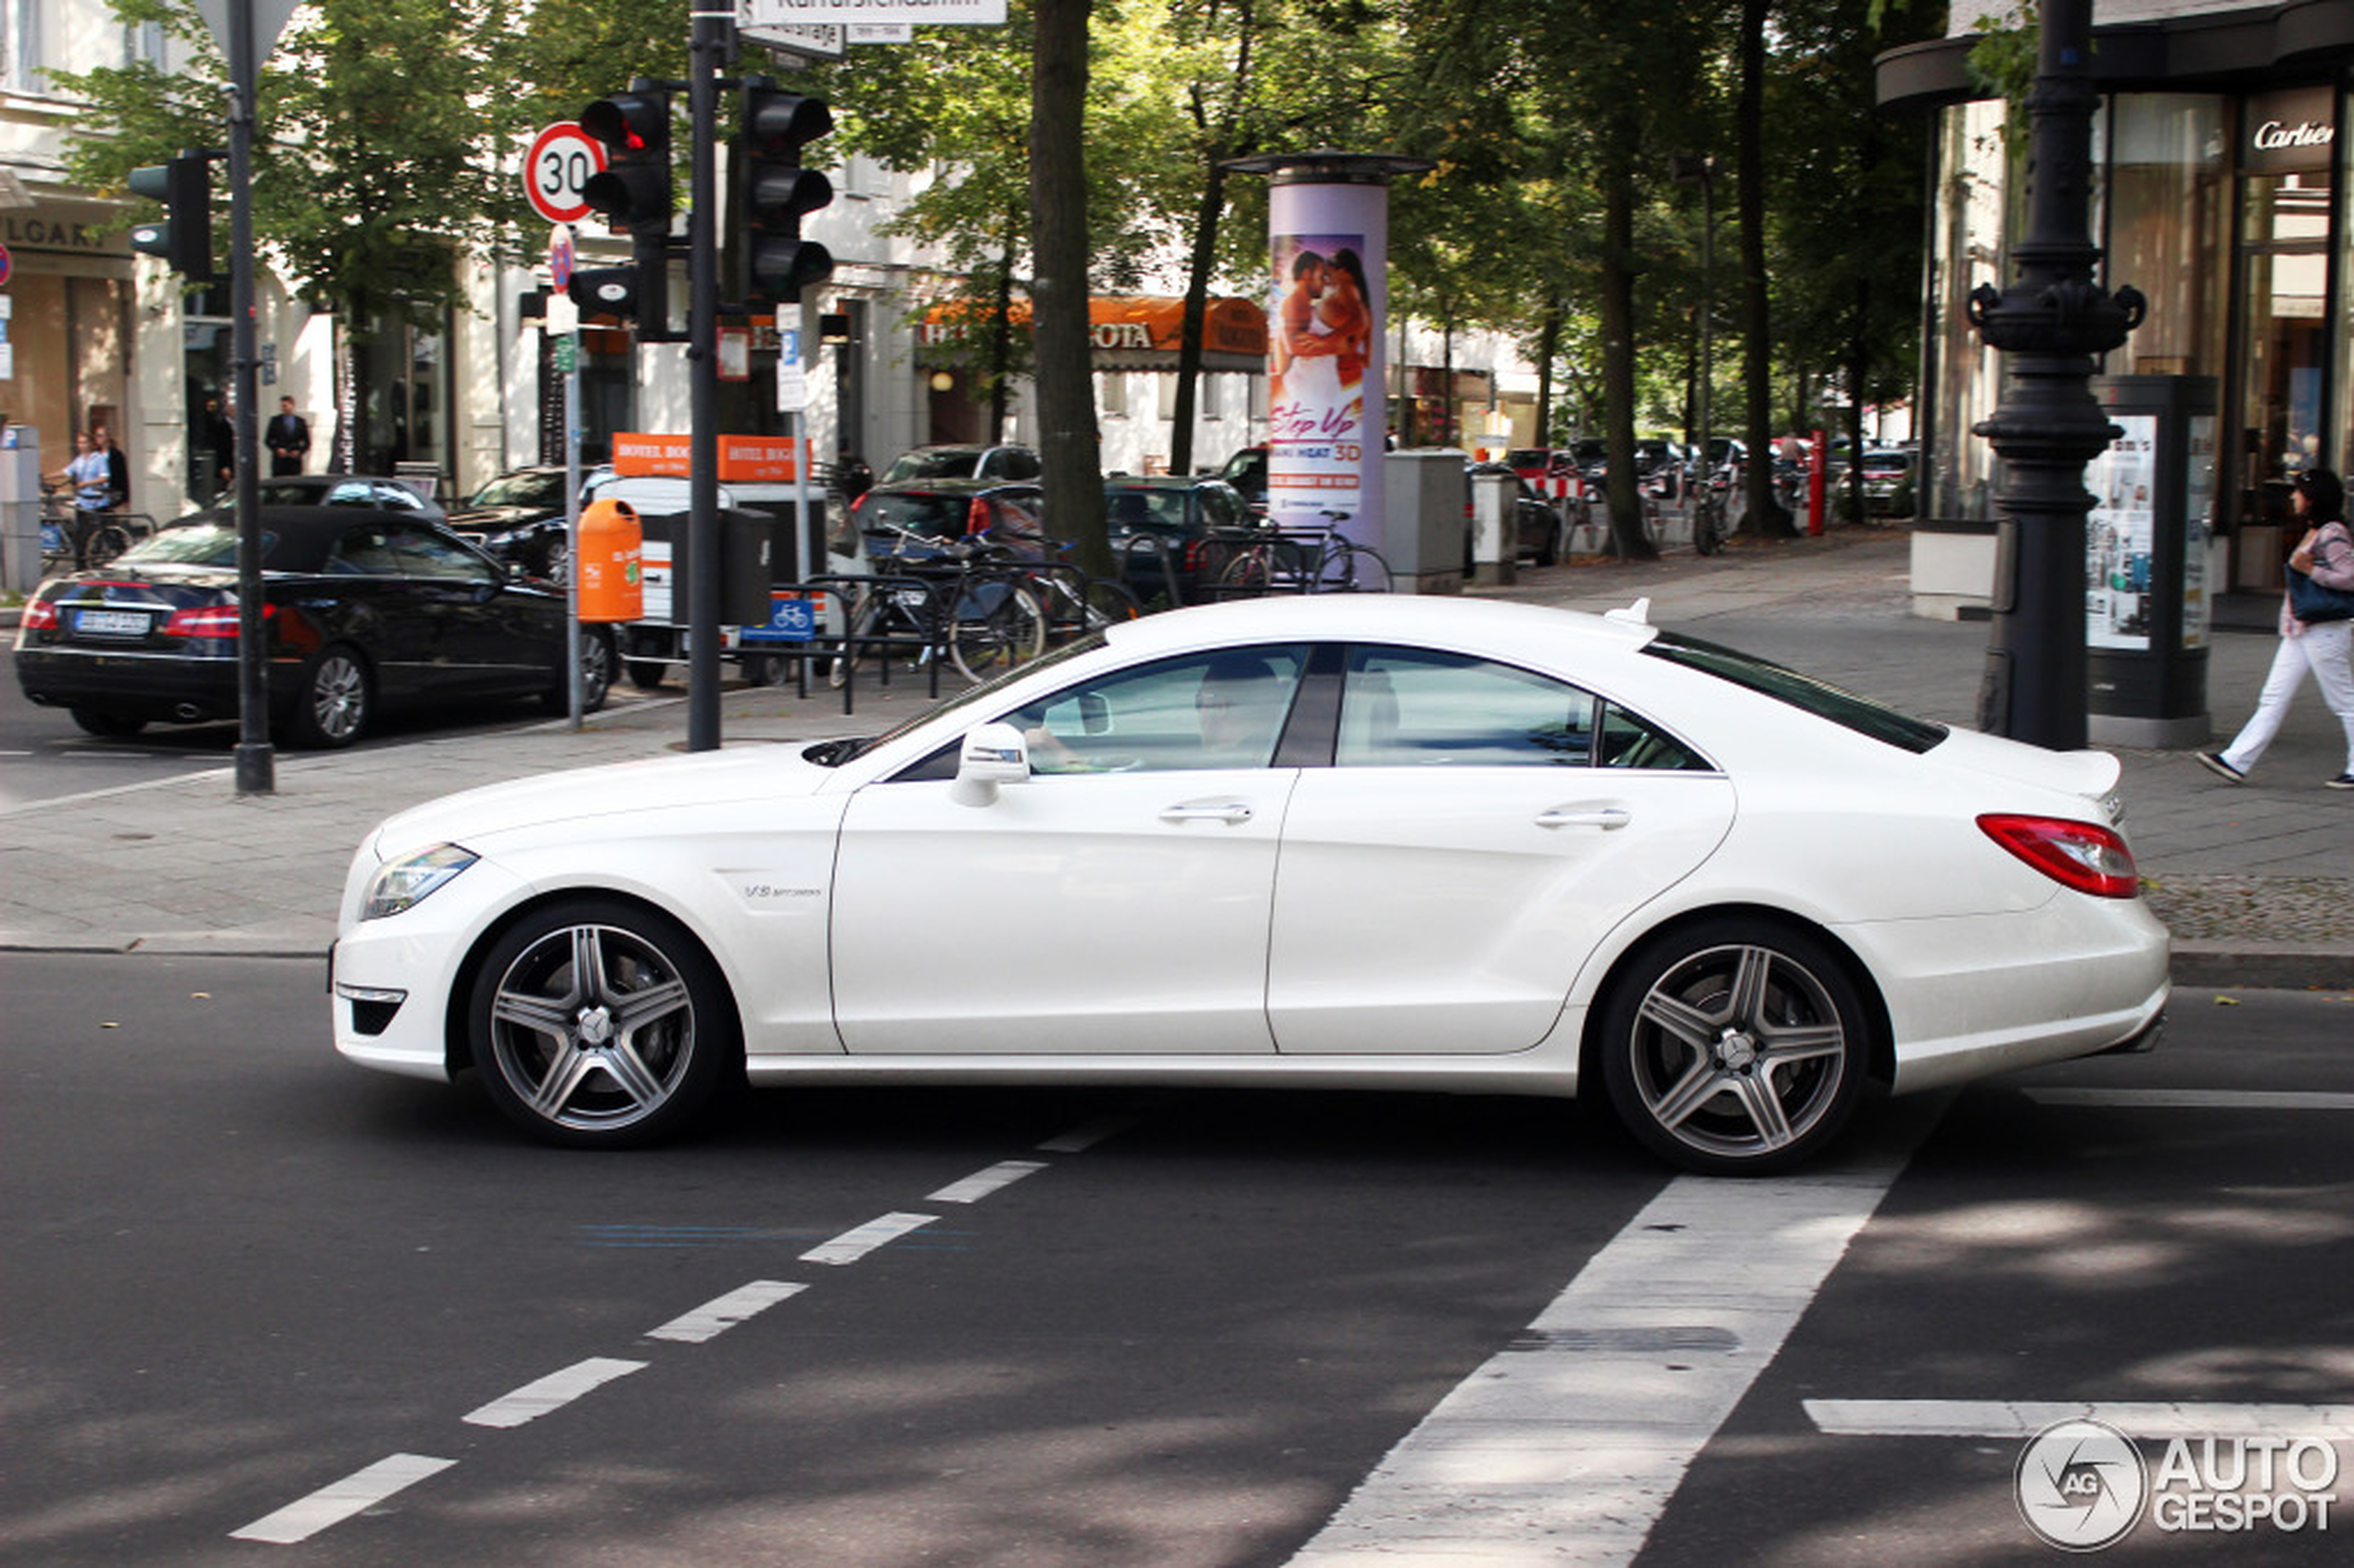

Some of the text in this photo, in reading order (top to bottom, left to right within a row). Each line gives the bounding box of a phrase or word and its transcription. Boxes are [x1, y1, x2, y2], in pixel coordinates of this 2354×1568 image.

[542, 151, 588, 196] 30
[1270, 401, 1356, 438] Step Up
[1334, 445, 1362, 462] 3D
